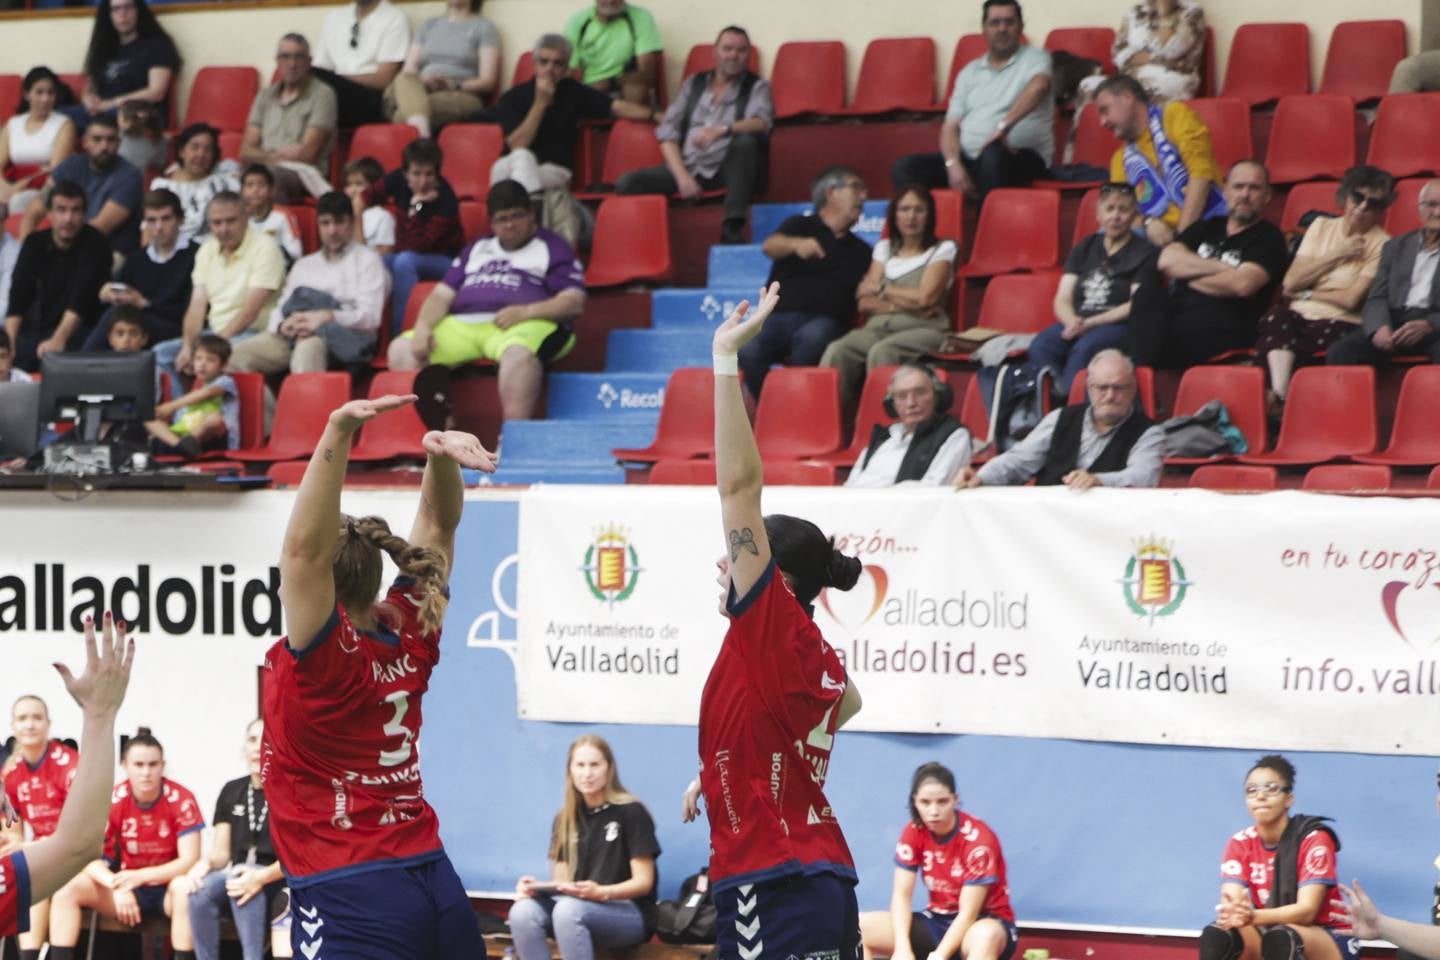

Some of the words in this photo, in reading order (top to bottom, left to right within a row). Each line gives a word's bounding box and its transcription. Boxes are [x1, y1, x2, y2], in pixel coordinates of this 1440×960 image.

[545, 620, 655, 640] Ayuntamiento
[659, 622, 679, 640] de
[1078, 635, 1200, 658] Ayuntamiento
[1206, 640, 1228, 659] de
[545, 644, 679, 675] Valladolid
[1077, 659, 1229, 696] Valladolid
[1281, 657, 1440, 697] info.vall
[377, 690, 416, 767] 3
